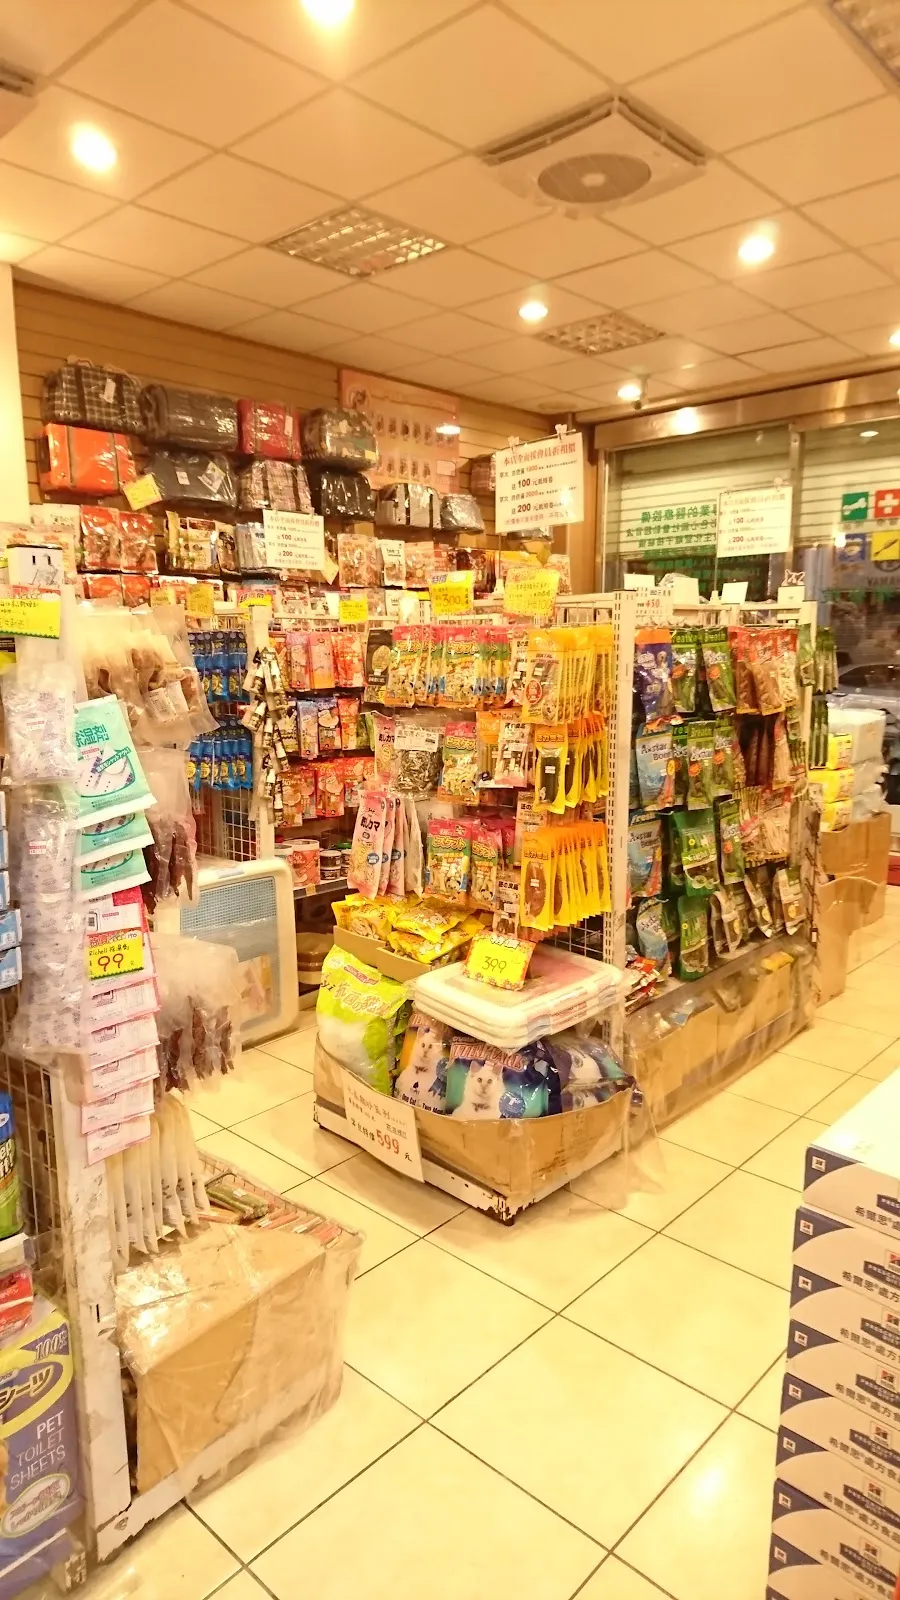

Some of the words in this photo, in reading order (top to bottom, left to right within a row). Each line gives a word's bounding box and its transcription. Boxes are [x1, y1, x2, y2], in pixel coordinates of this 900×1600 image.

[518, 478, 531, 488] 100
[517, 503, 531, 513] 200
[442, 593, 461, 607] 300
[89, 948, 107, 956] Richell
[97, 953, 124, 972] 99
[481, 955, 507, 974] 399
[375, 1129, 401, 1154] 599
[37, 1411, 64, 1440] PET
[17, 1428, 64, 1466] TOILET
[10, 1445, 66, 1490] SHEETS
